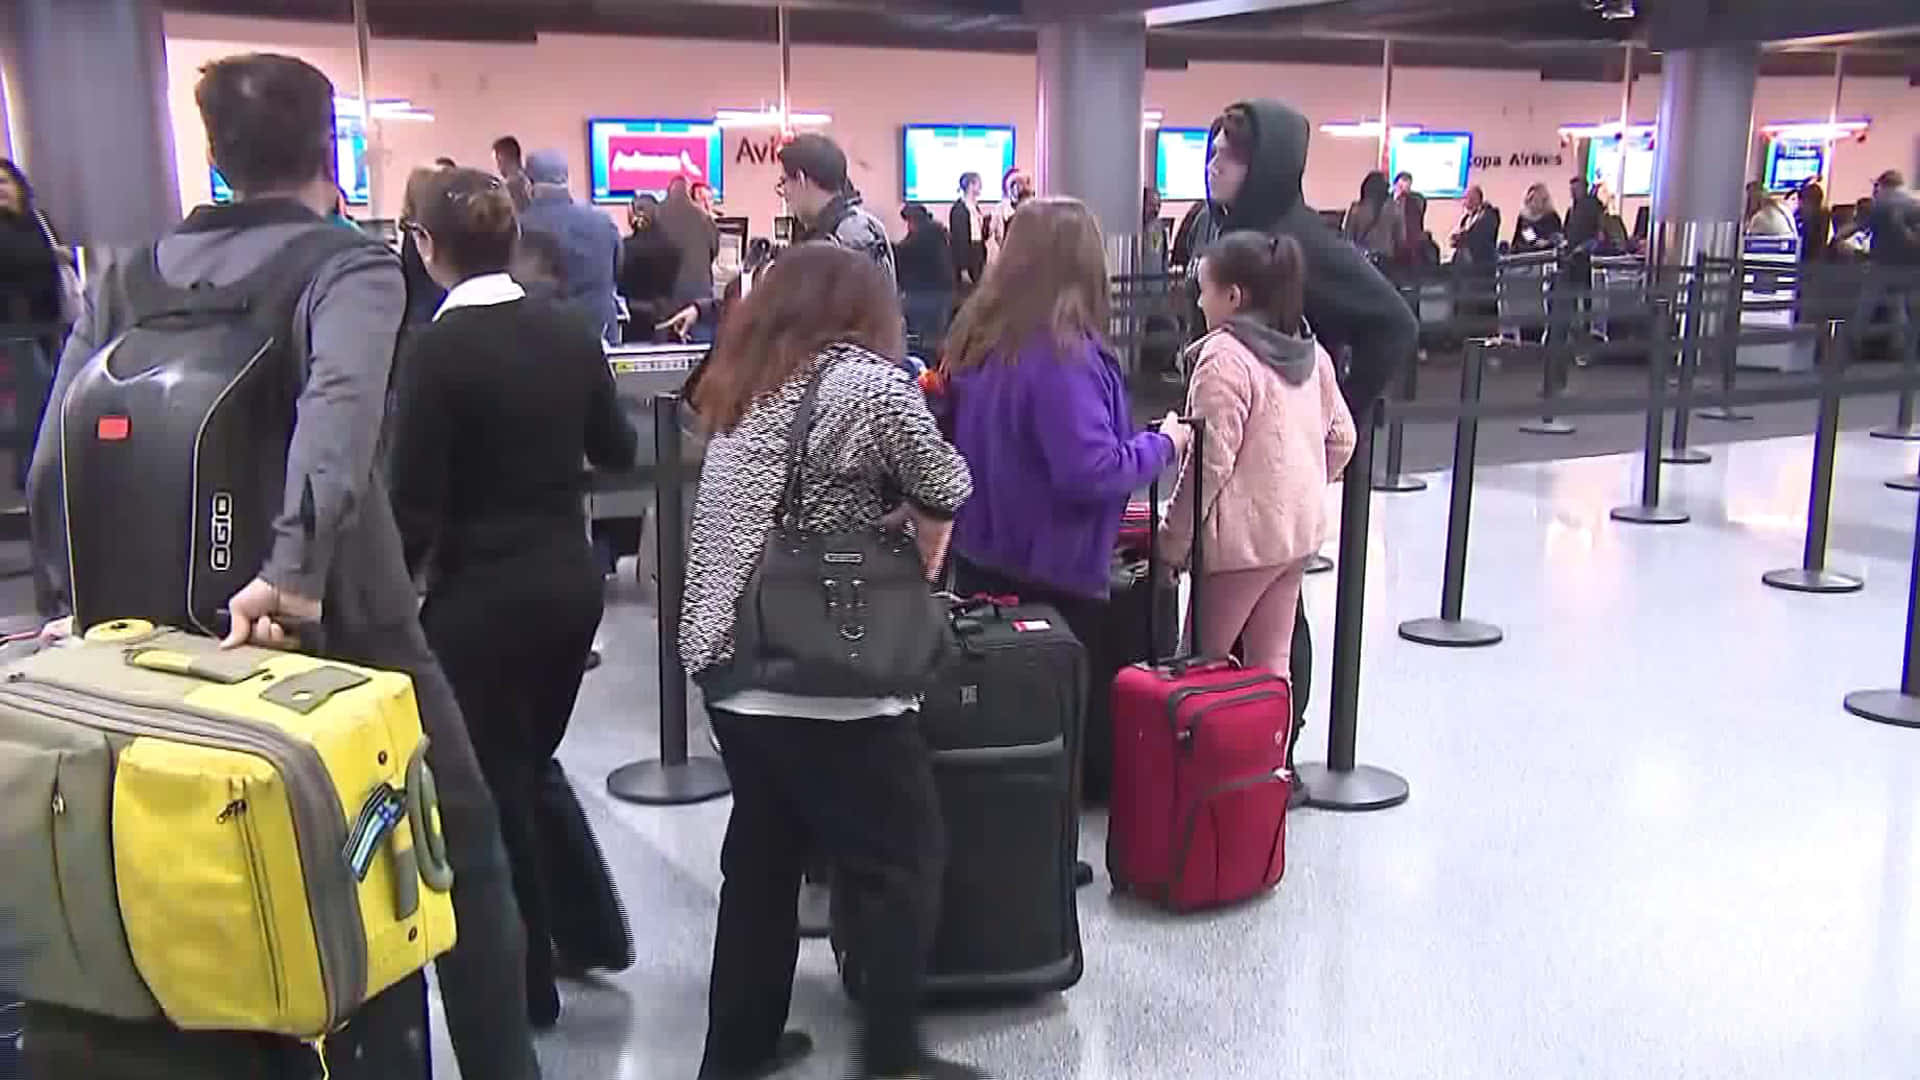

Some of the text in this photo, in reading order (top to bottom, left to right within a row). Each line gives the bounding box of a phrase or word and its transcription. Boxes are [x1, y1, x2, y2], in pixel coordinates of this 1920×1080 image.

[736, 136, 781, 164] Avi
[1469, 155, 1502, 171] opa
[211, 492, 232, 571] OGIO
